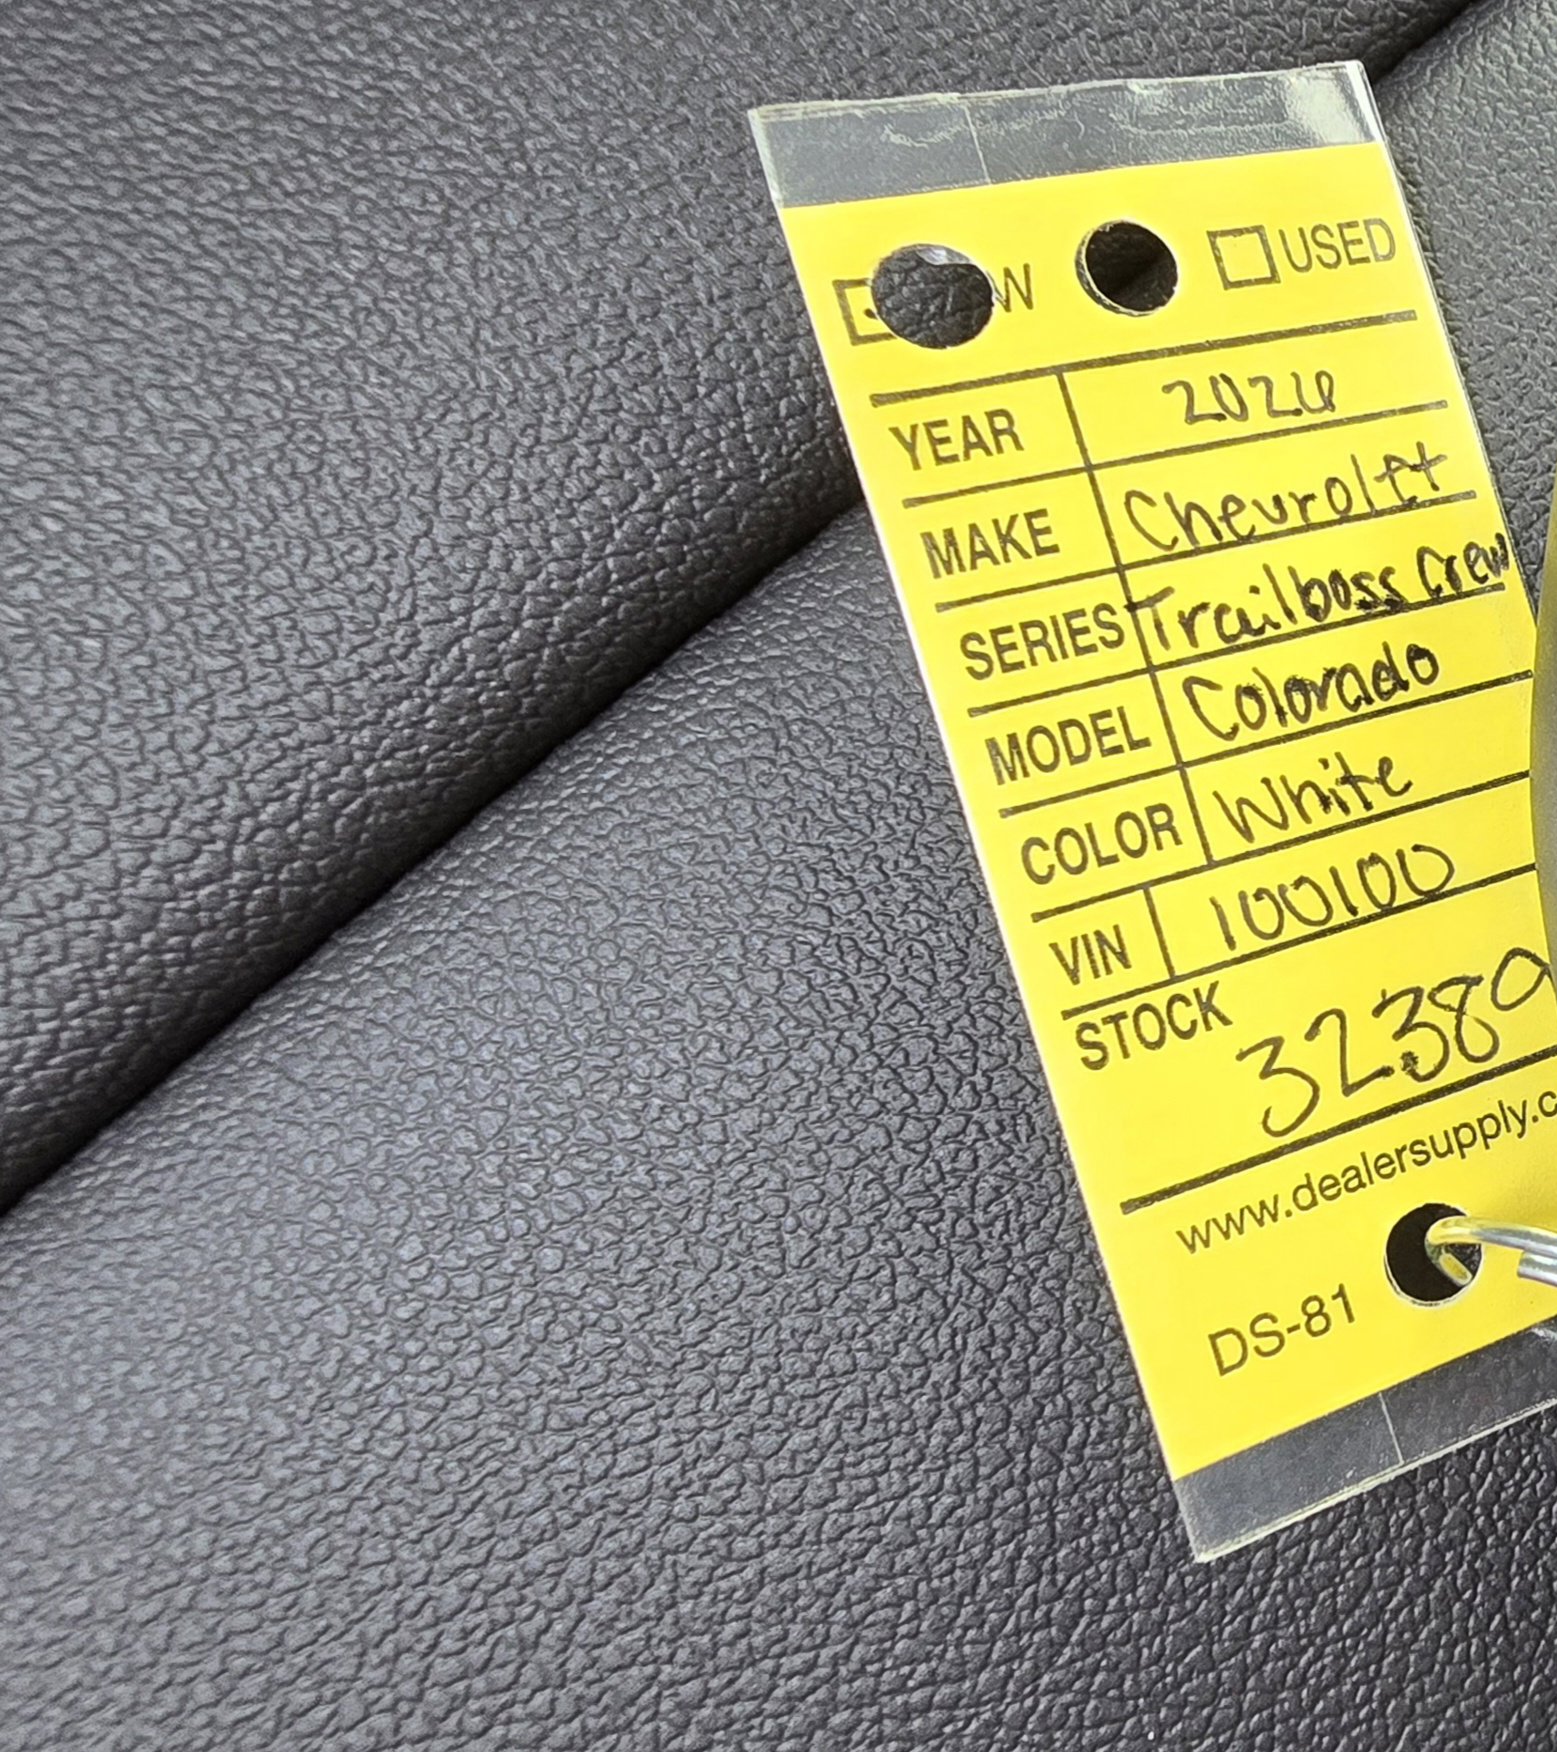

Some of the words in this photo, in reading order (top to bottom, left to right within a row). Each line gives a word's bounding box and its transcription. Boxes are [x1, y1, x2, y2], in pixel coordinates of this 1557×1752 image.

[1279, 217, 1396, 274] USED
[1161, 370, 1336, 425] 2026
[889, 408, 1024, 471] YEAR
[1125, 440, 1448, 552] Chevrolet
[920, 508, 1060, 579] MAKE
[1124, 563, 1397, 652] Trailboss
[1417, 532, 1509, 597] Crew
[960, 603, 1125, 681] SERIES
[1182, 641, 1440, 741] Colorado
[985, 706, 1152, 786] MODEL
[1218, 750, 1413, 844] White
[1020, 805, 1184, 885] COLOR
[1209, 842, 1456, 950] 100100
[1048, 924, 1133, 986] VIN
[1076, 980, 1233, 1072] STOCK
[1207, 1283, 1358, 1377] DS-81
